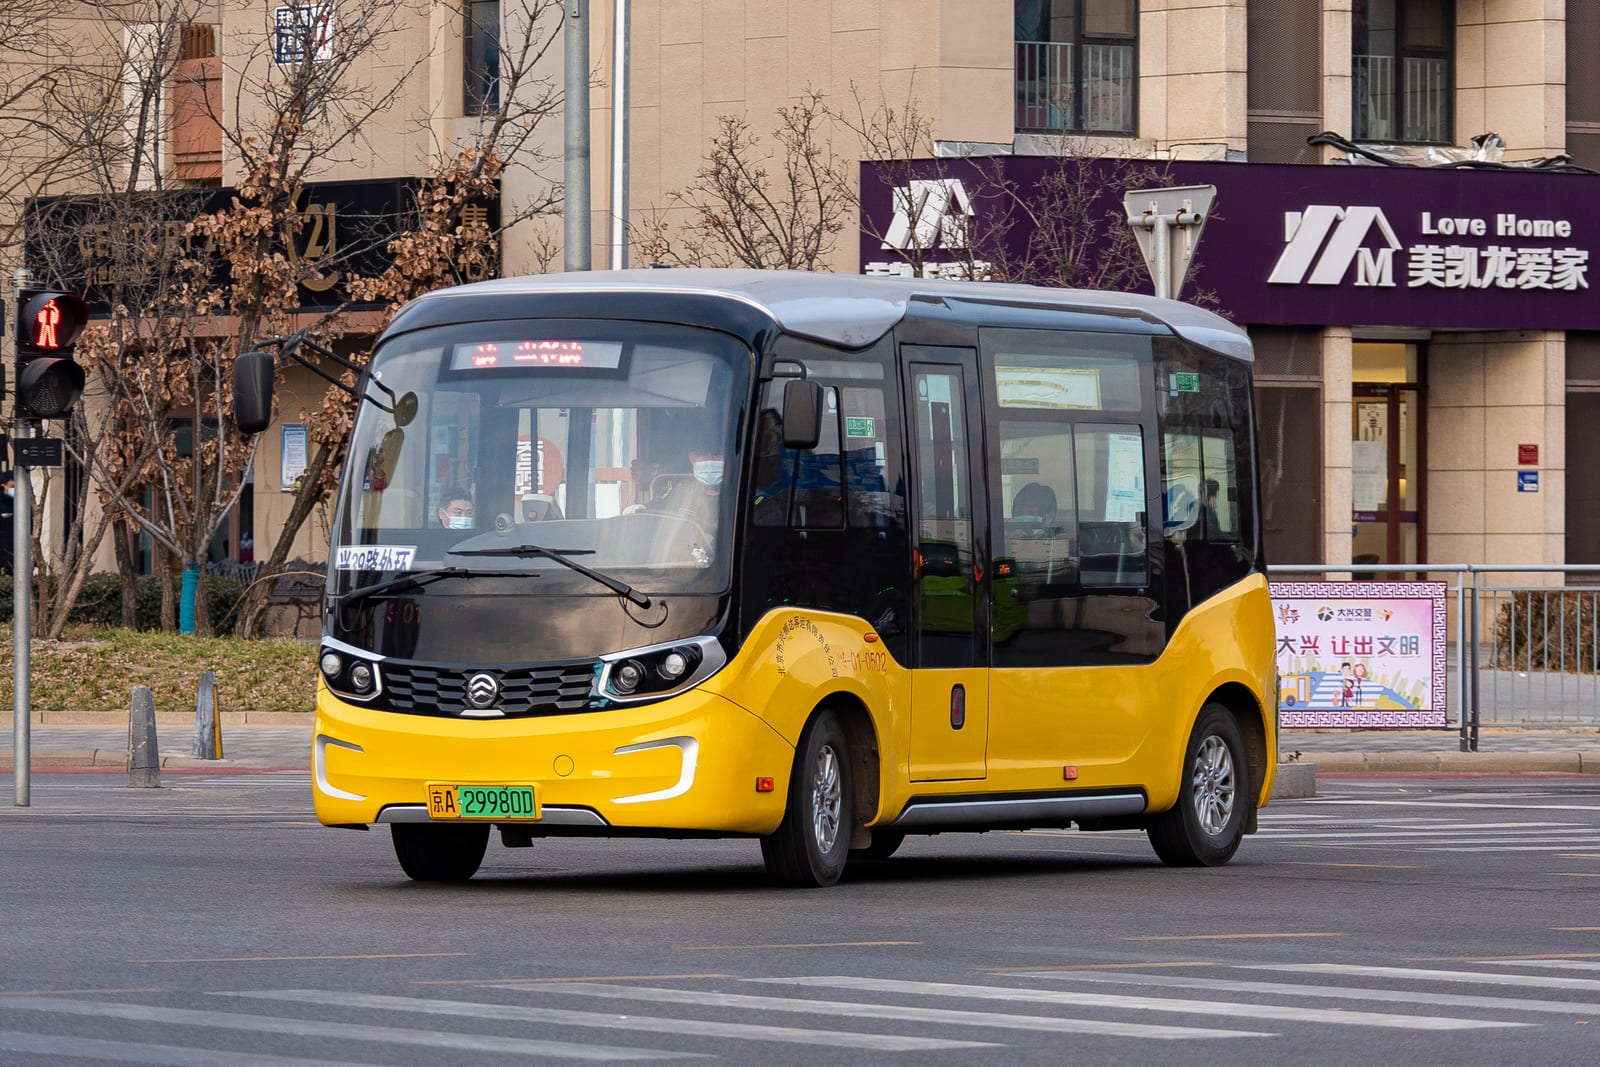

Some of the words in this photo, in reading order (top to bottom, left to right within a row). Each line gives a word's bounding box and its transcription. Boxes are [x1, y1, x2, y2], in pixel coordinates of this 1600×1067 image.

[1421, 211, 1487, 236] Love
[1496, 212, 1572, 238] Home
[1408, 245, 1590, 290] 美凯龙爱家
[1330, 635, 1420, 655] 让出文明
